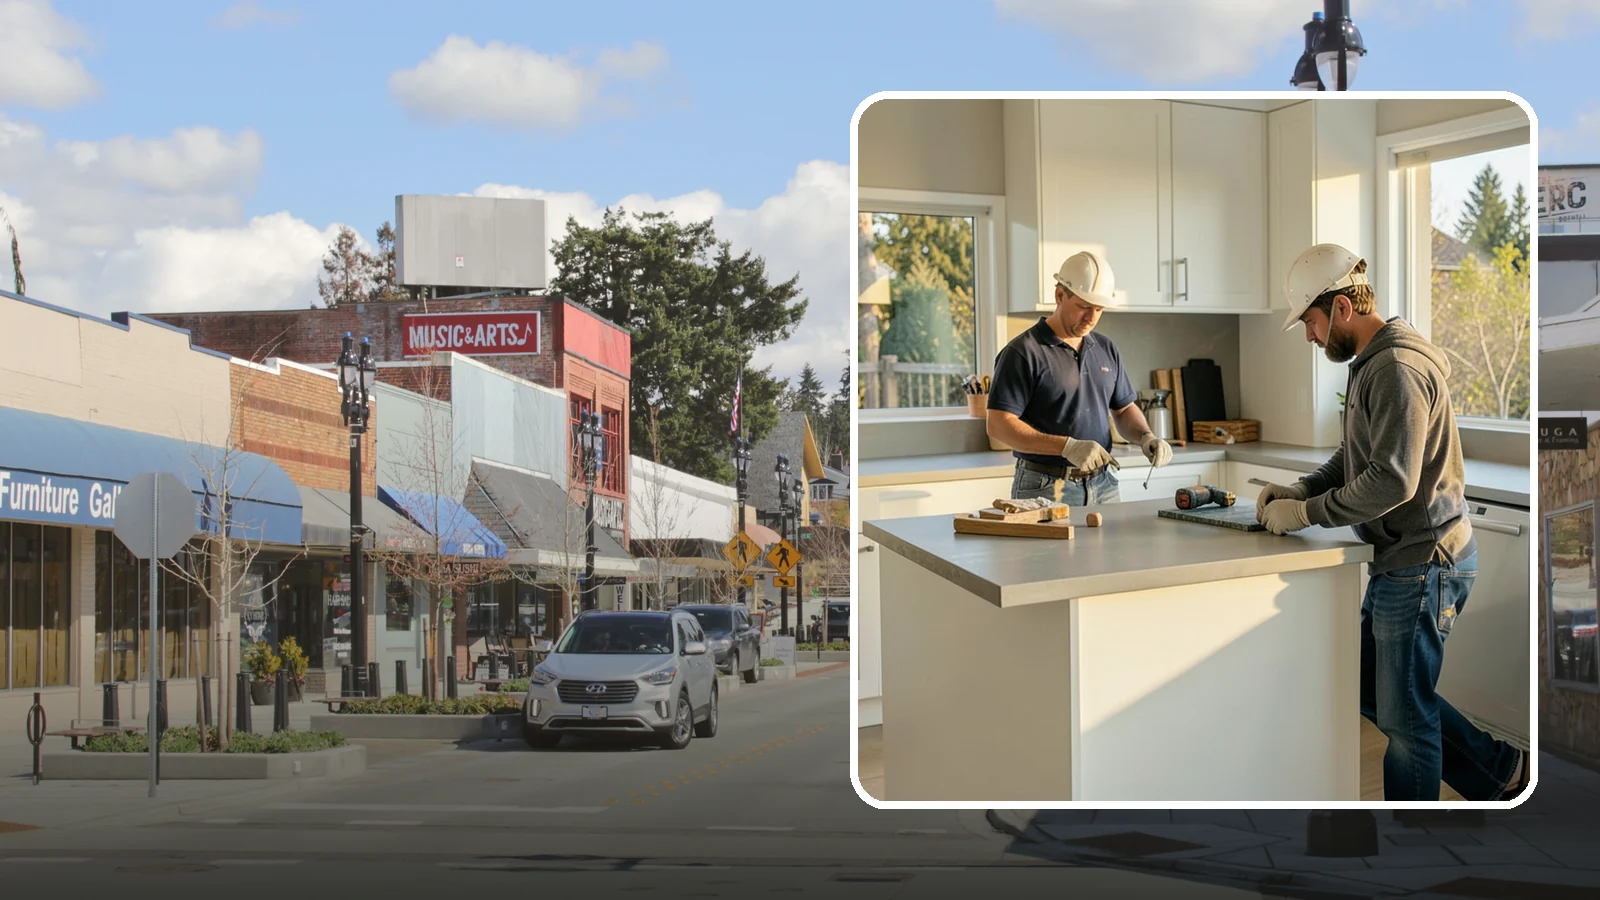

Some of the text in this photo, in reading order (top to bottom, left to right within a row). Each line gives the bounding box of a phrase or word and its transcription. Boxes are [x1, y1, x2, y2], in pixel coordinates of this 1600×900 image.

[409, 323, 520, 348] MUSIC&ARTS
[0, 471, 79, 515] Furniture
[453, 563, 480, 574] SUSHI
